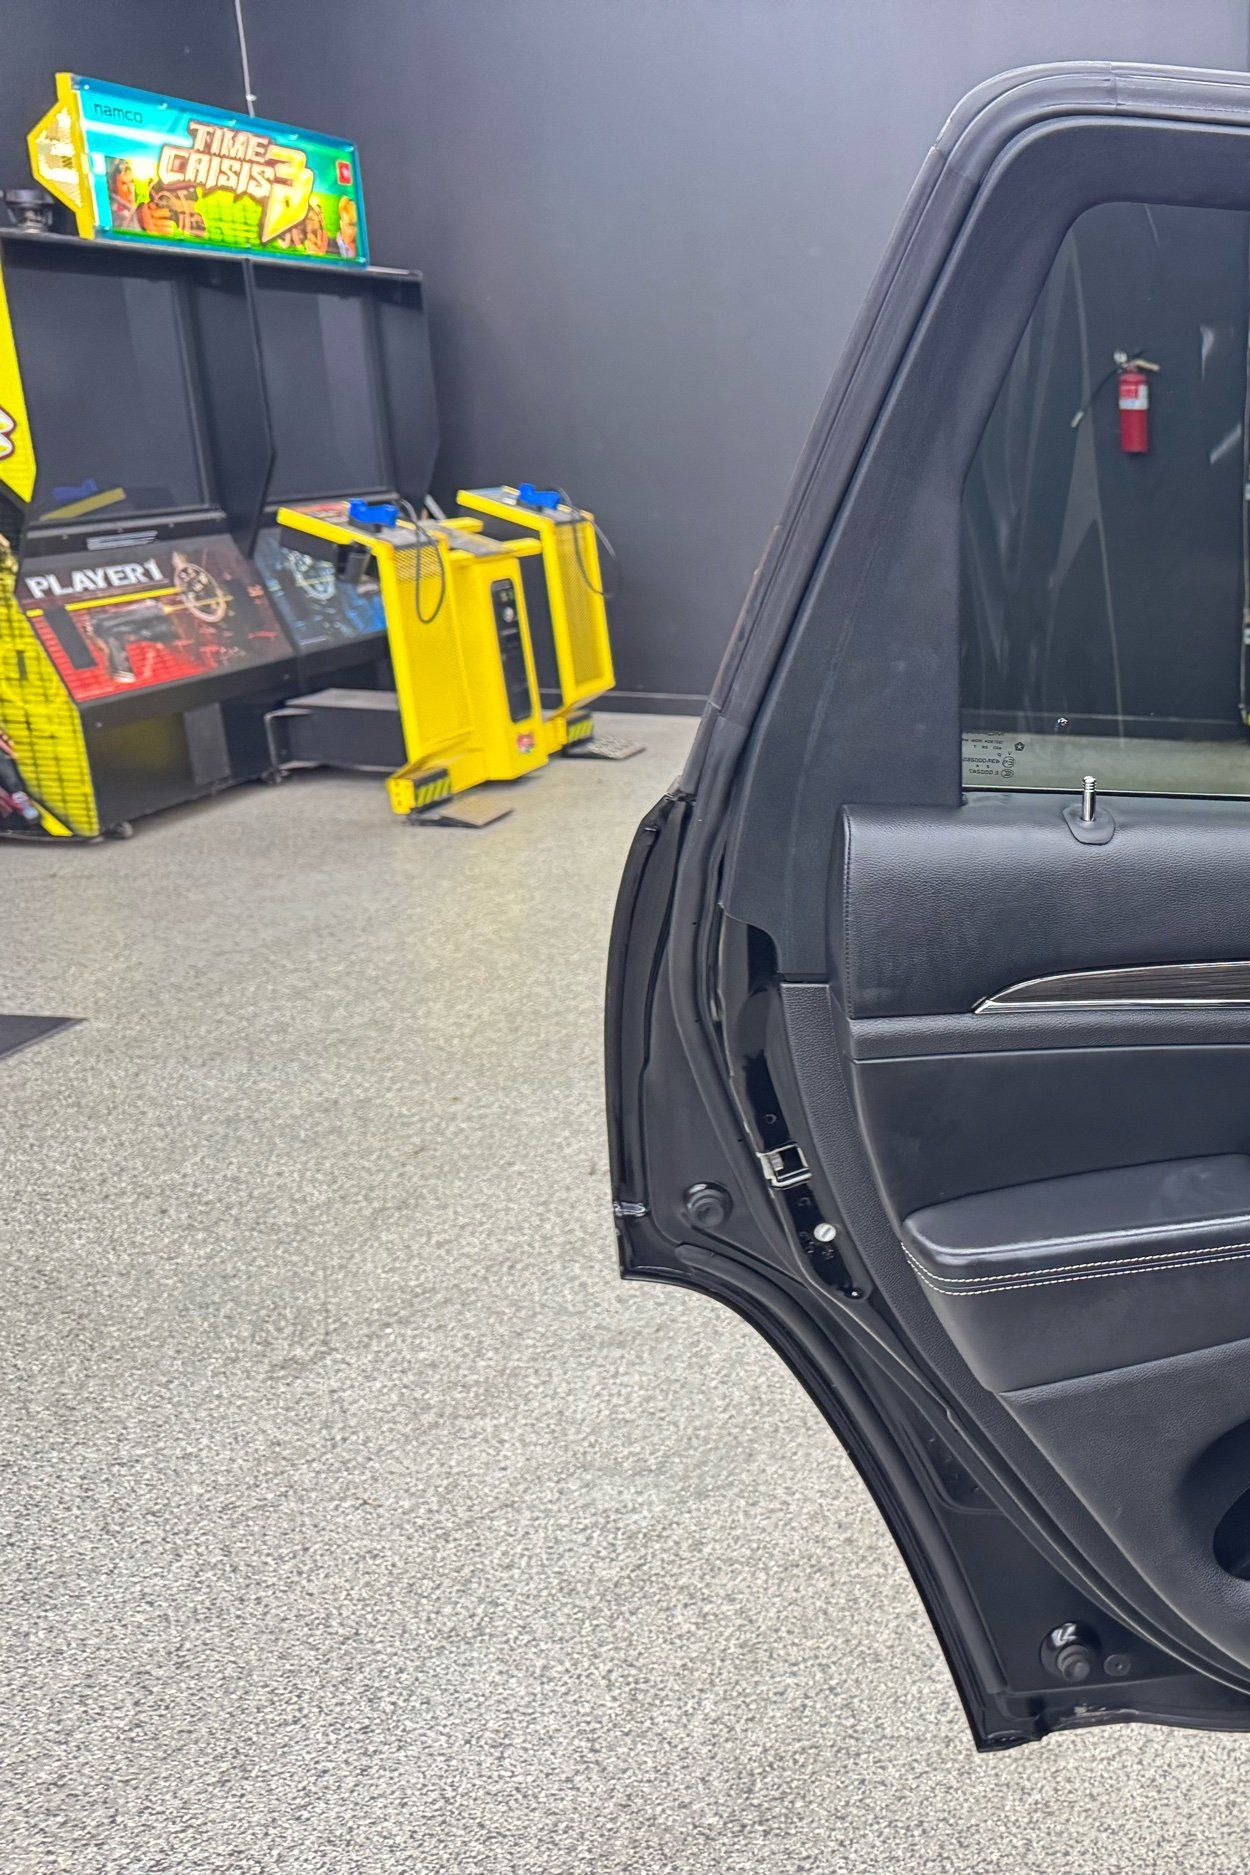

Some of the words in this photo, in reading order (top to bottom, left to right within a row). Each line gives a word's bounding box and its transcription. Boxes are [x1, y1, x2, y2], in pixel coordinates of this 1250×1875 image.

[93, 101, 143, 124] namco
[188, 120, 270, 163] TIME
[158, 145, 276, 199] CRISIS
